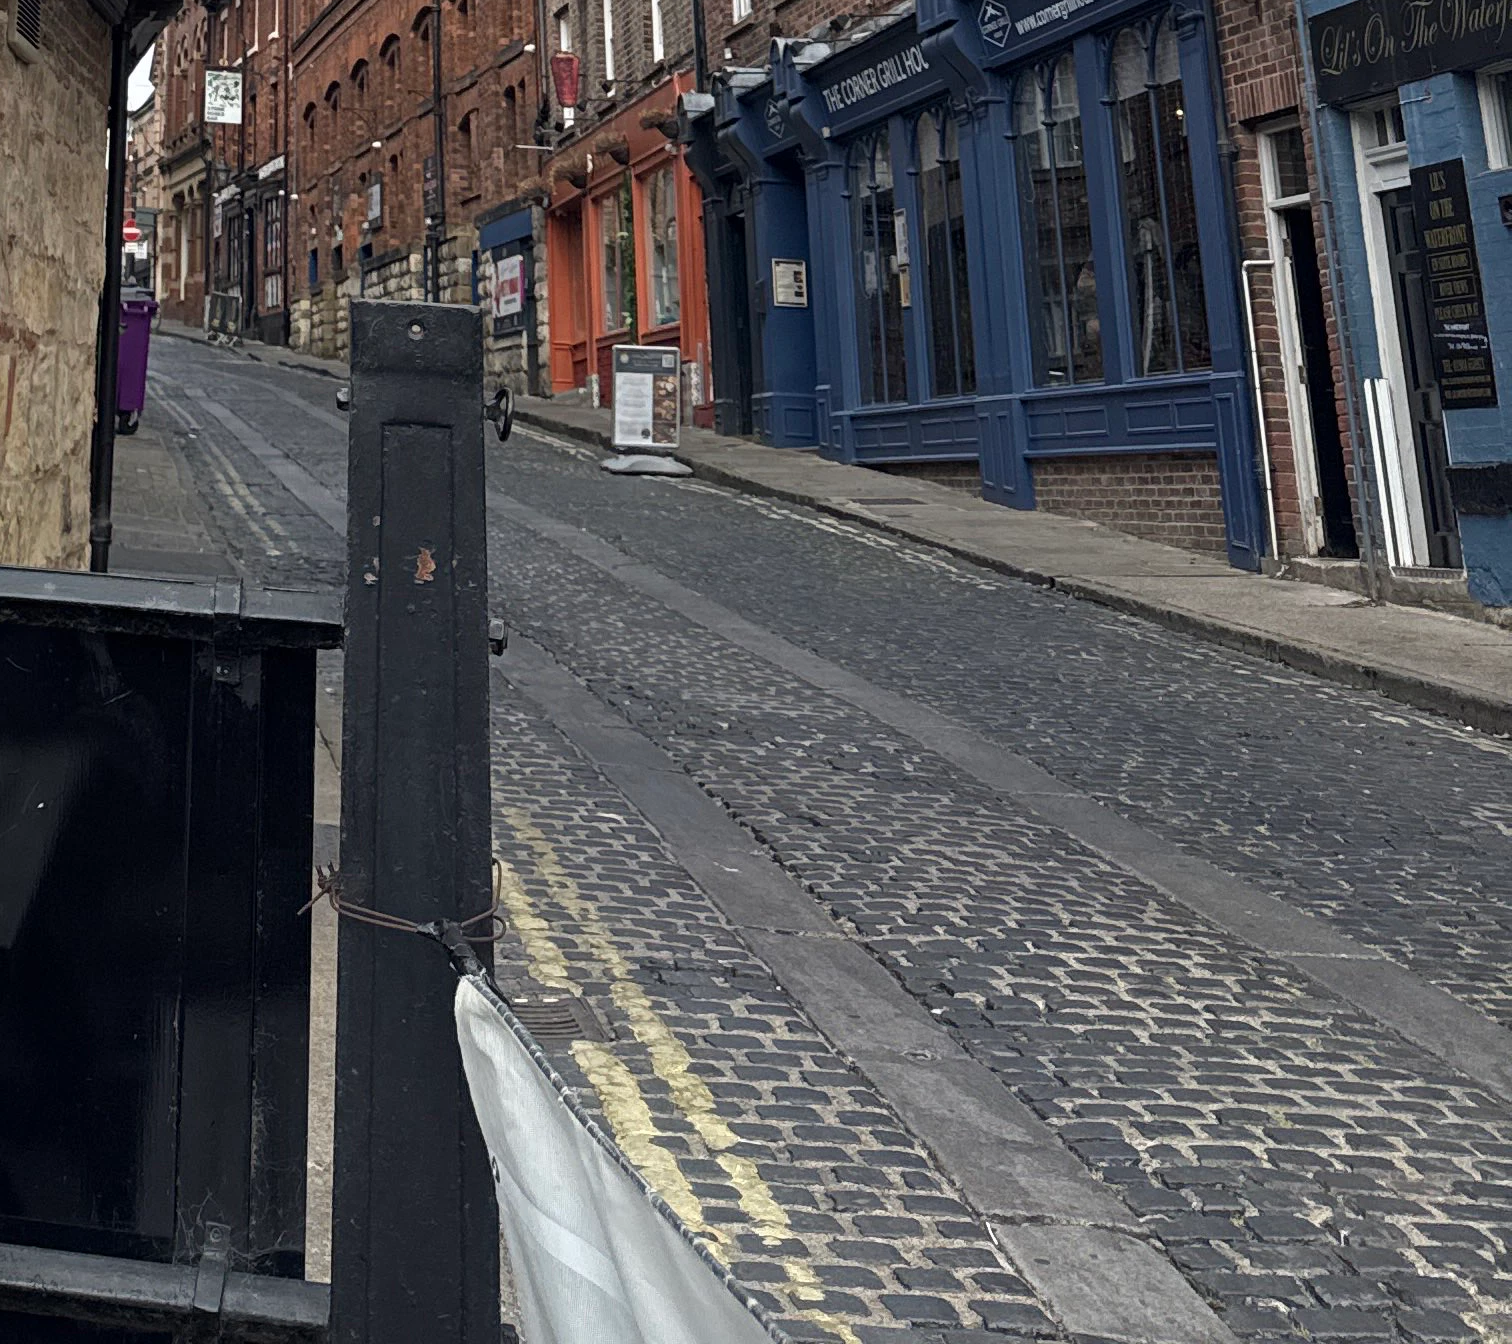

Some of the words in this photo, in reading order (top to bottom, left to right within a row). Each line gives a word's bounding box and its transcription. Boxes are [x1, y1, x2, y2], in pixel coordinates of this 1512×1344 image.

[1320, 25, 1361, 76] Lil's
[1364, 13, 1396, 64] On
[822, 83, 844, 113] THE
[840, 67, 882, 105] CORNER
[877, 54, 907, 88] GRILL
